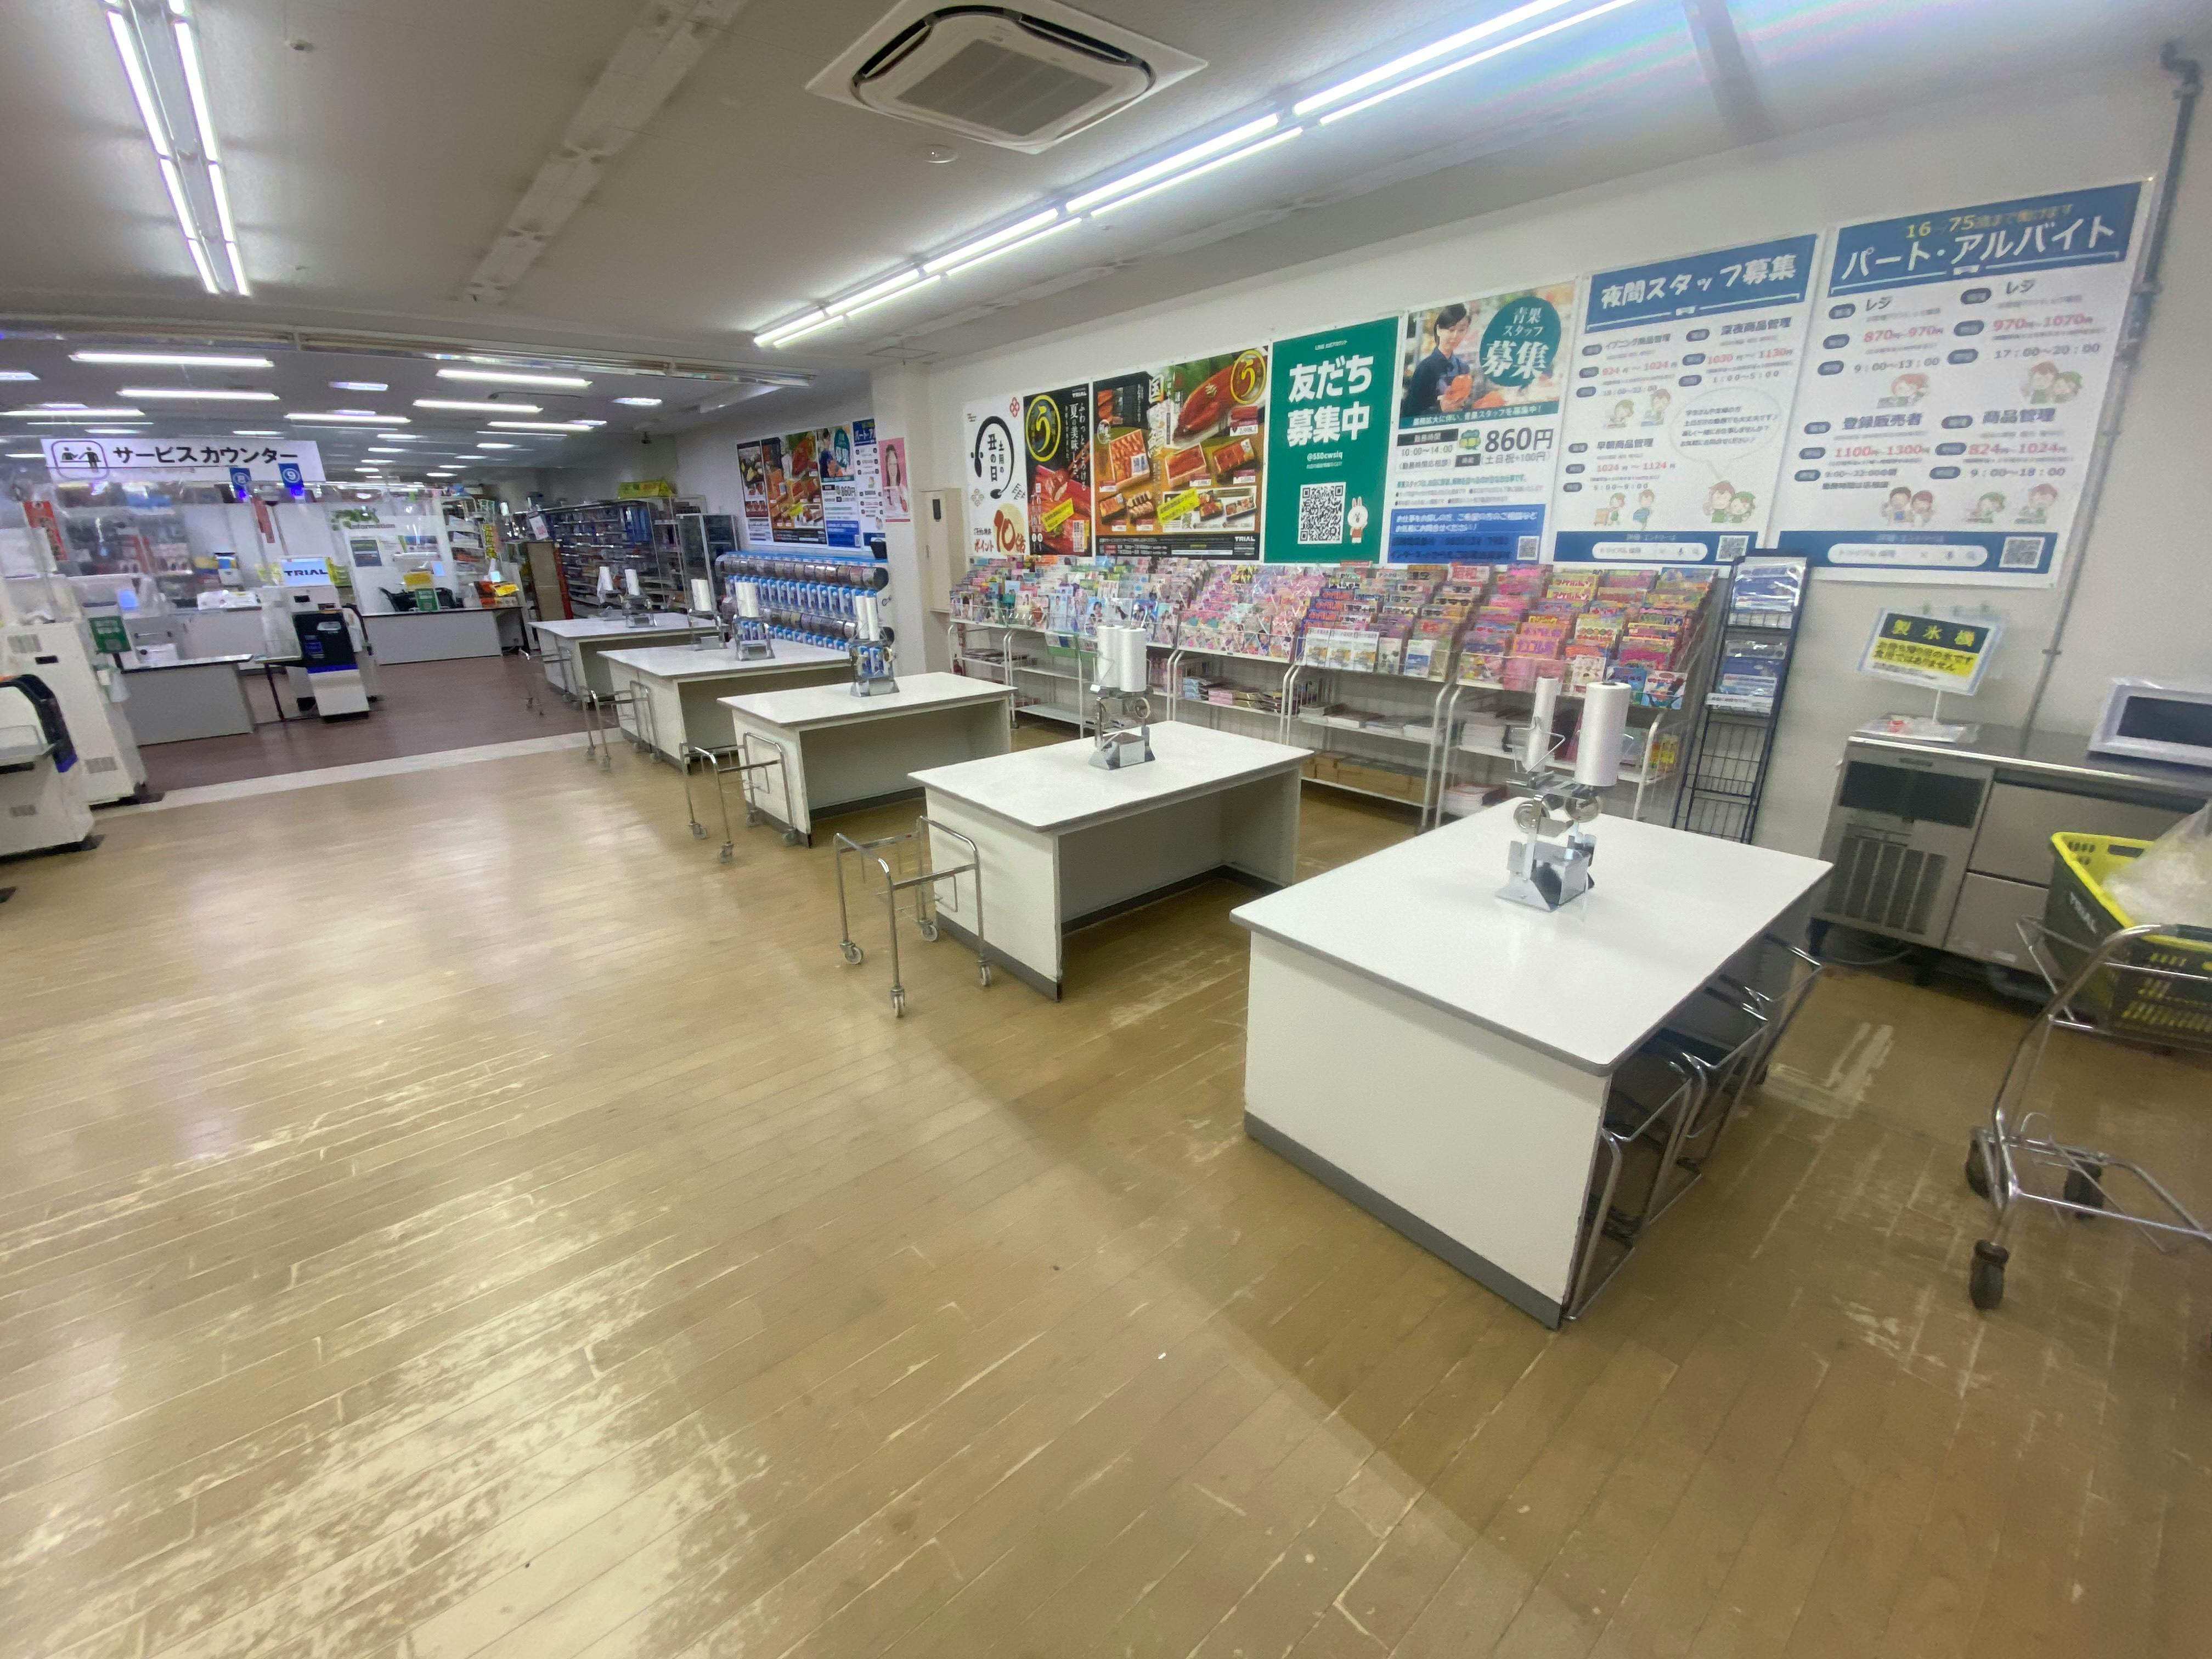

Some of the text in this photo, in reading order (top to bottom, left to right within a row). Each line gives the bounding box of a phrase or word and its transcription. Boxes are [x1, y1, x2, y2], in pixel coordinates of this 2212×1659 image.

[1841, 215, 2115, 280] パート・アルバイト
[1601, 254, 1797, 309] 夜間スタッフ募集
[1502, 325, 1544, 337] スタッフ
[1288, 354, 1374, 403] 友だち
[1482, 340, 1549, 380] 募集
[1287, 401, 1371, 447] 募集中
[1485, 427, 1554, 453] 860円
[112, 445, 298, 464] サービスカウンター
[283, 568, 329, 577] TRIAL
